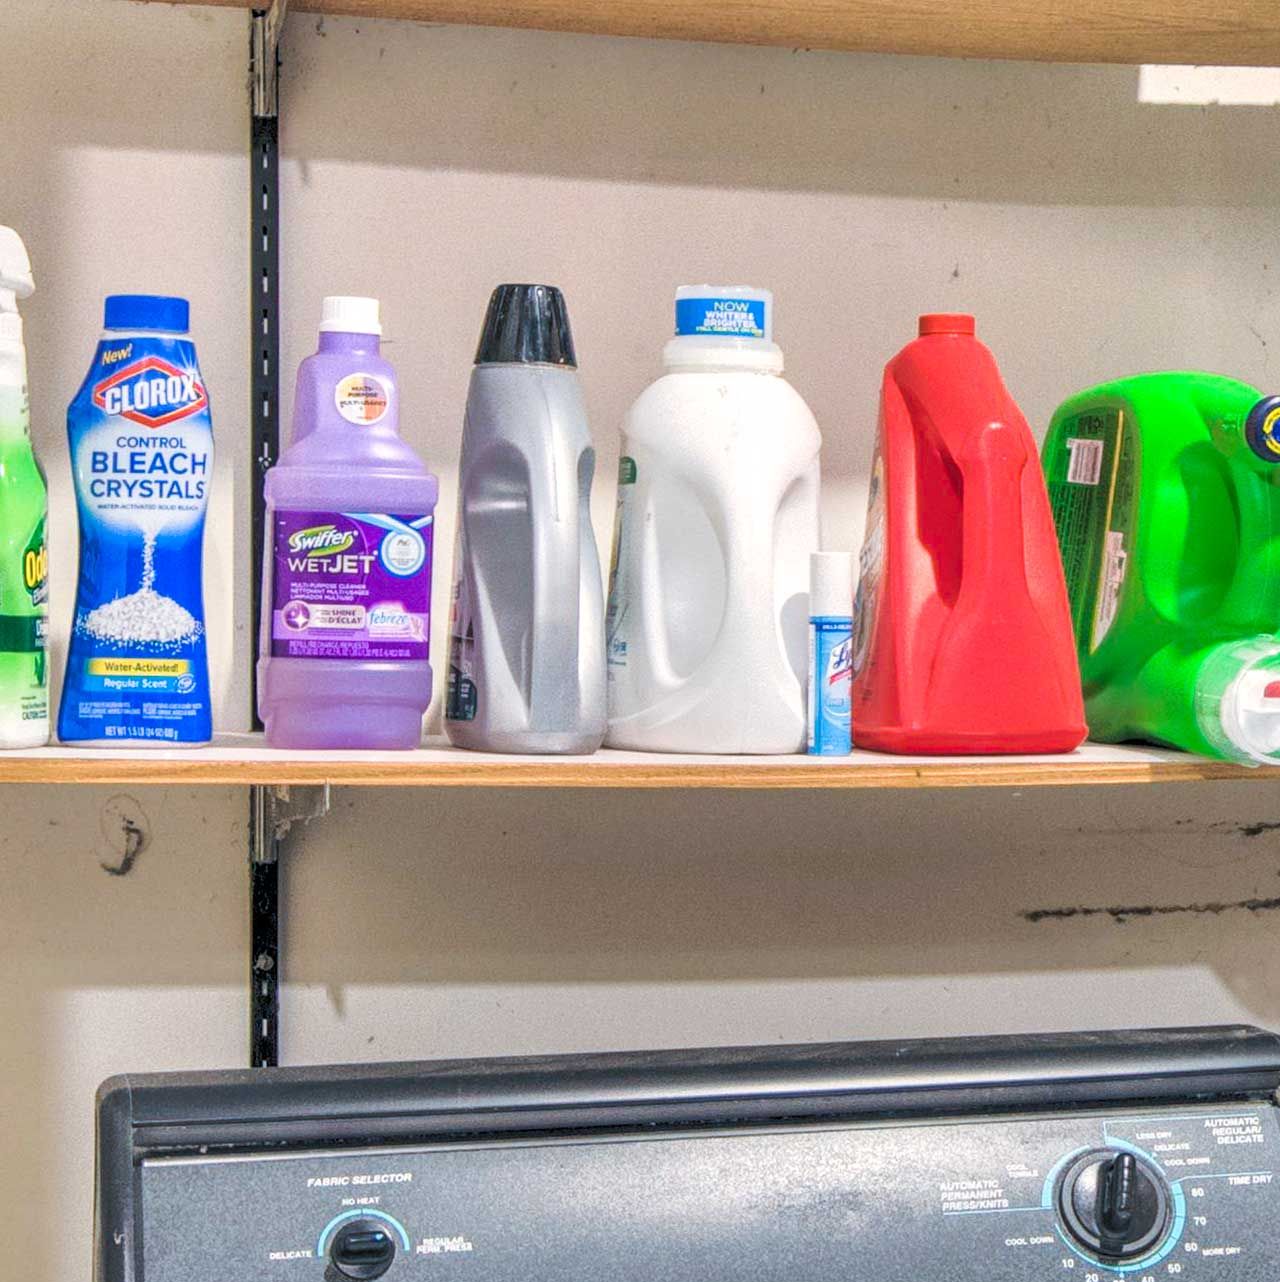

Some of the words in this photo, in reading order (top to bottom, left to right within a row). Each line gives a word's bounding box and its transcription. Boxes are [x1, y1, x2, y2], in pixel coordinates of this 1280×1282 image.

[713, 301, 749, 312] NOW
[101, 343, 133, 366] New!
[104, 374, 198, 416] CLOROX
[116, 436, 187, 449] CONTROL
[91, 451, 207, 475] BLEACH
[90, 478, 206, 500] CRYSTALS
[289, 529, 354, 553] Swiffer
[287, 554, 376, 574] WETJET
[369, 610, 409, 625] febreze
[104, 662, 179, 673] Water-Activated!
[104, 678, 139, 690] Regular
[141, 679, 168, 689] Scent
[1204, 1117, 1260, 1128] AUTOMATIC
[1212, 1126, 1262, 1137] REGULAR/
[1217, 1134, 1264, 1145] DELICATE
[1154, 1143, 1191, 1152] DELICATE
[306, 1176, 350, 1188] FABRIC
[351, 1173, 413, 1186] SELECTOR
[940, 1180, 999, 1191] AUTOMATIC
[1229, 1176, 1251, 1186] TIME
[1252, 1174, 1273, 1184] DRY
[941, 1189, 1004, 1200] PERMANENT
[342, 1199, 355, 1207] NO
[356, 1197, 380, 1205] HEAT
[942, 1199, 1009, 1211] PRESS/KNITS
[1193, 1216, 1207, 1227] 70
[1005, 1238, 1028, 1247] COOL
[1184, 1242, 1198, 1253] 60
[269, 1251, 313, 1261] DELICATE
[1202, 1247, 1225, 1257] MORE
[1225, 1246, 1241, 1256] DRY
[1062, 1259, 1075, 1269] 10
[1168, 1263, 1182, 1274] 50
